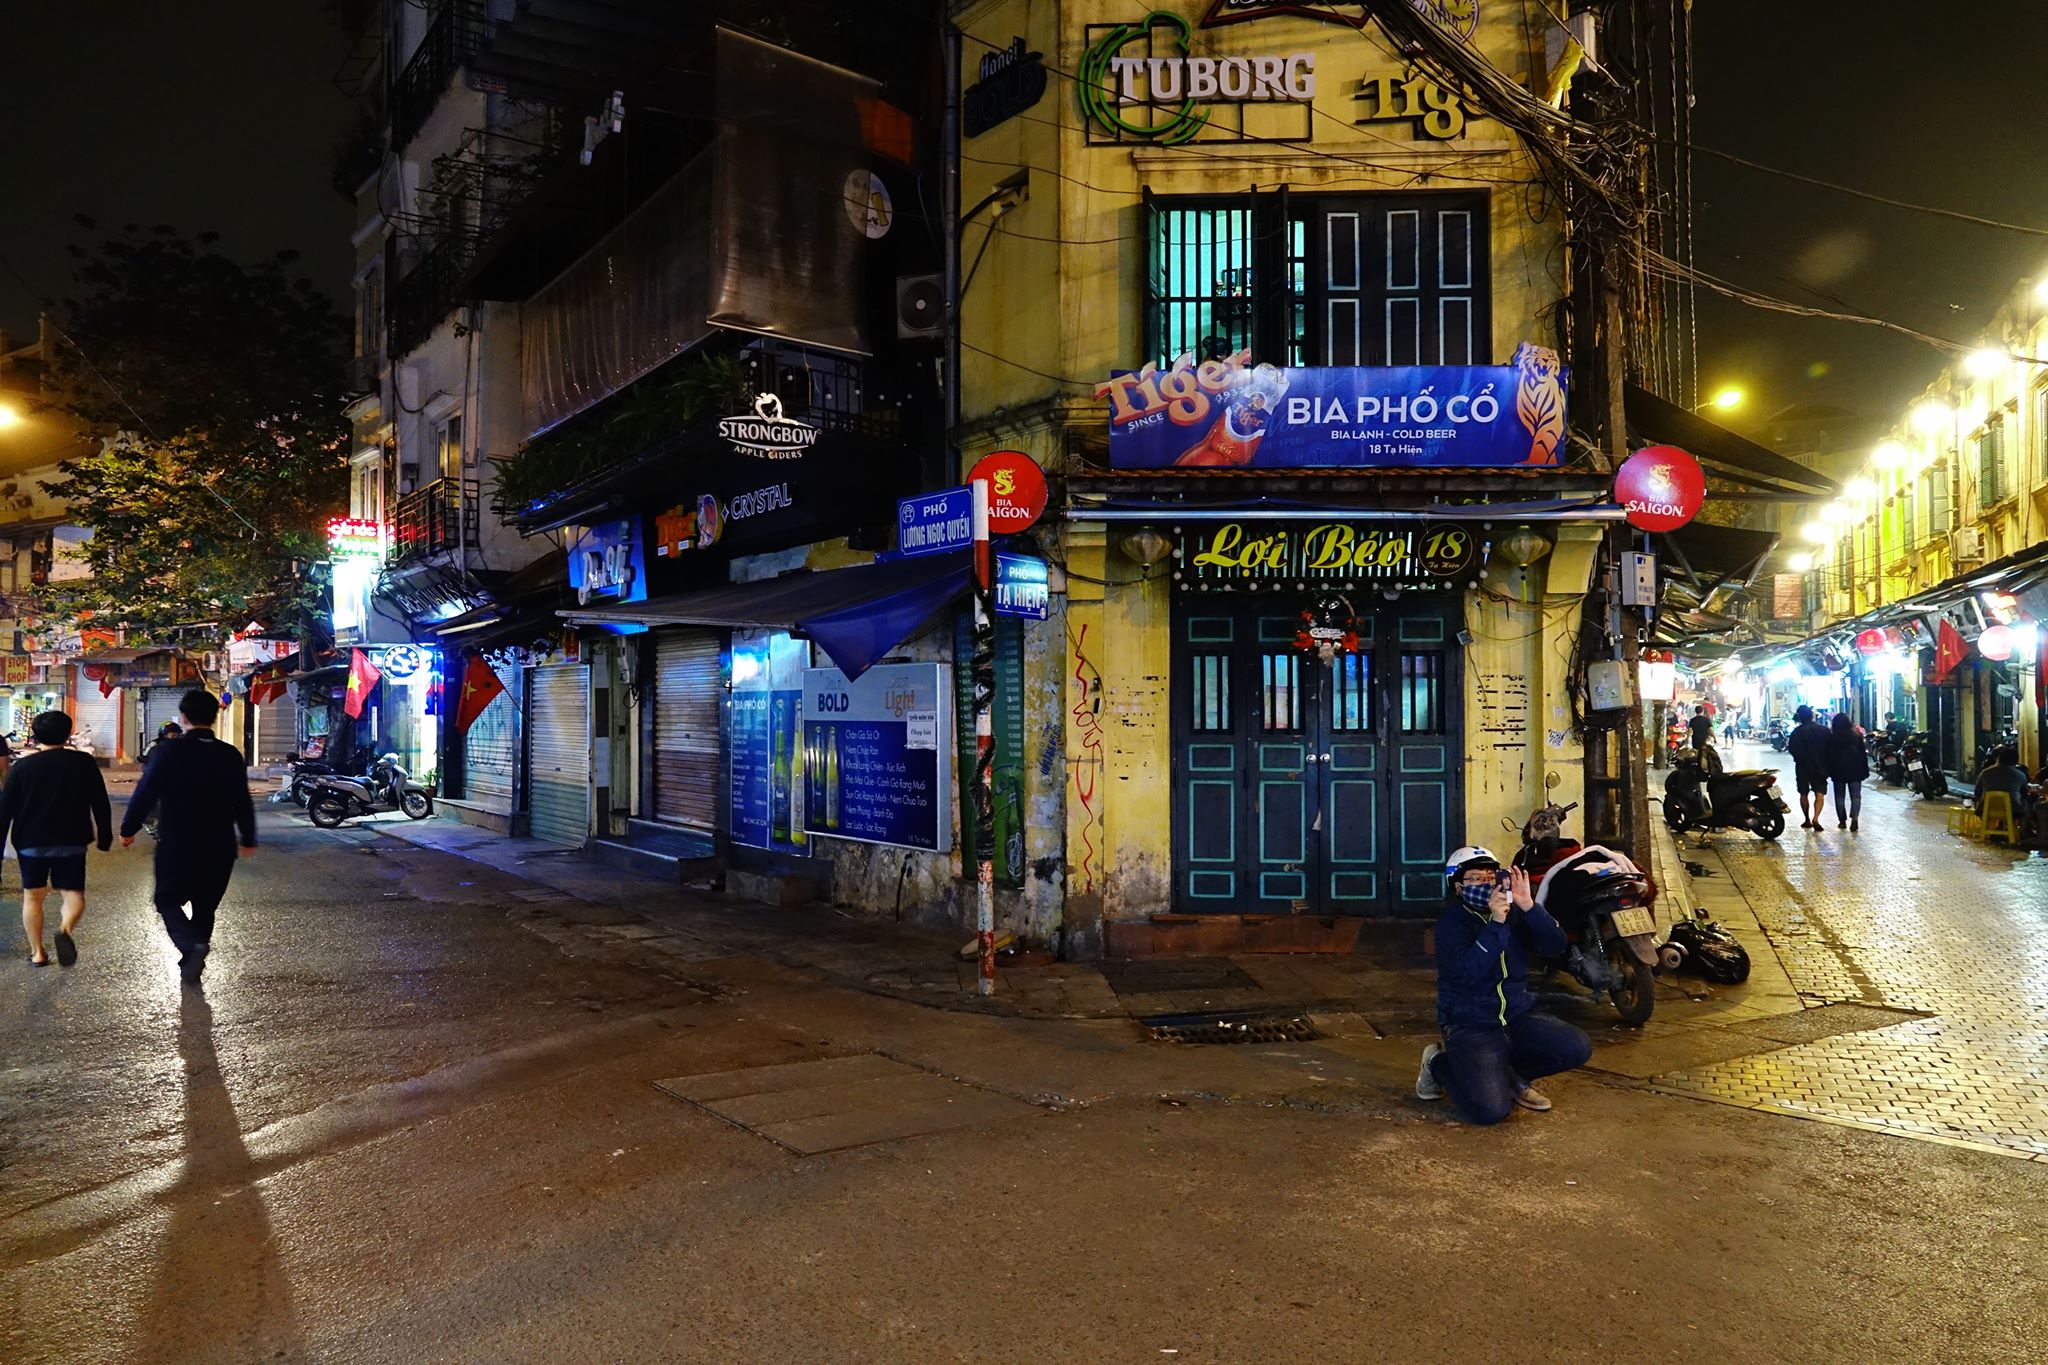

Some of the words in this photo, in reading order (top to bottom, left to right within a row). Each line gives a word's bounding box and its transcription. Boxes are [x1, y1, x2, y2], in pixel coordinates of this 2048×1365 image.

[1111, 52, 1316, 104] TUBORG
[1093, 347, 1252, 426] Tiger
[1287, 397, 1349, 424] BIA
[1357, 385, 1438, 424] PHỐ
[1446, 383, 1499, 424] CỔ
[1127, 412, 1165, 431] SINCE
[718, 421, 818, 445] STRONGBOW
[1331, 429, 1351, 439] BIA
[1352, 429, 1384, 441] LẠNH
[1392, 429, 1425, 439] COLD
[1426, 429, 1457, 439] BEER
[734, 445, 764, 458] APPLE
[768, 450, 803, 460] CIDERS
[1369, 444, 1381, 454] 18
[731, 482, 792, 520] CRYSTAL
[923, 497, 948, 518] PHỐ
[996, 499, 1012, 507] BIA
[1629, 500, 1682, 517] SAIGON
[987, 507, 1030, 519] AIGON
[1193, 524, 1288, 577] Lợi
[1304, 524, 1411, 568] Béo
[1425, 531, 1467, 559] 18
[1008, 564, 1028, 580] PHỐ
[996, 583, 1011, 609] TẠ
[7, 671, 27, 683] SHOP
[818, 693, 849, 712] BOLD
